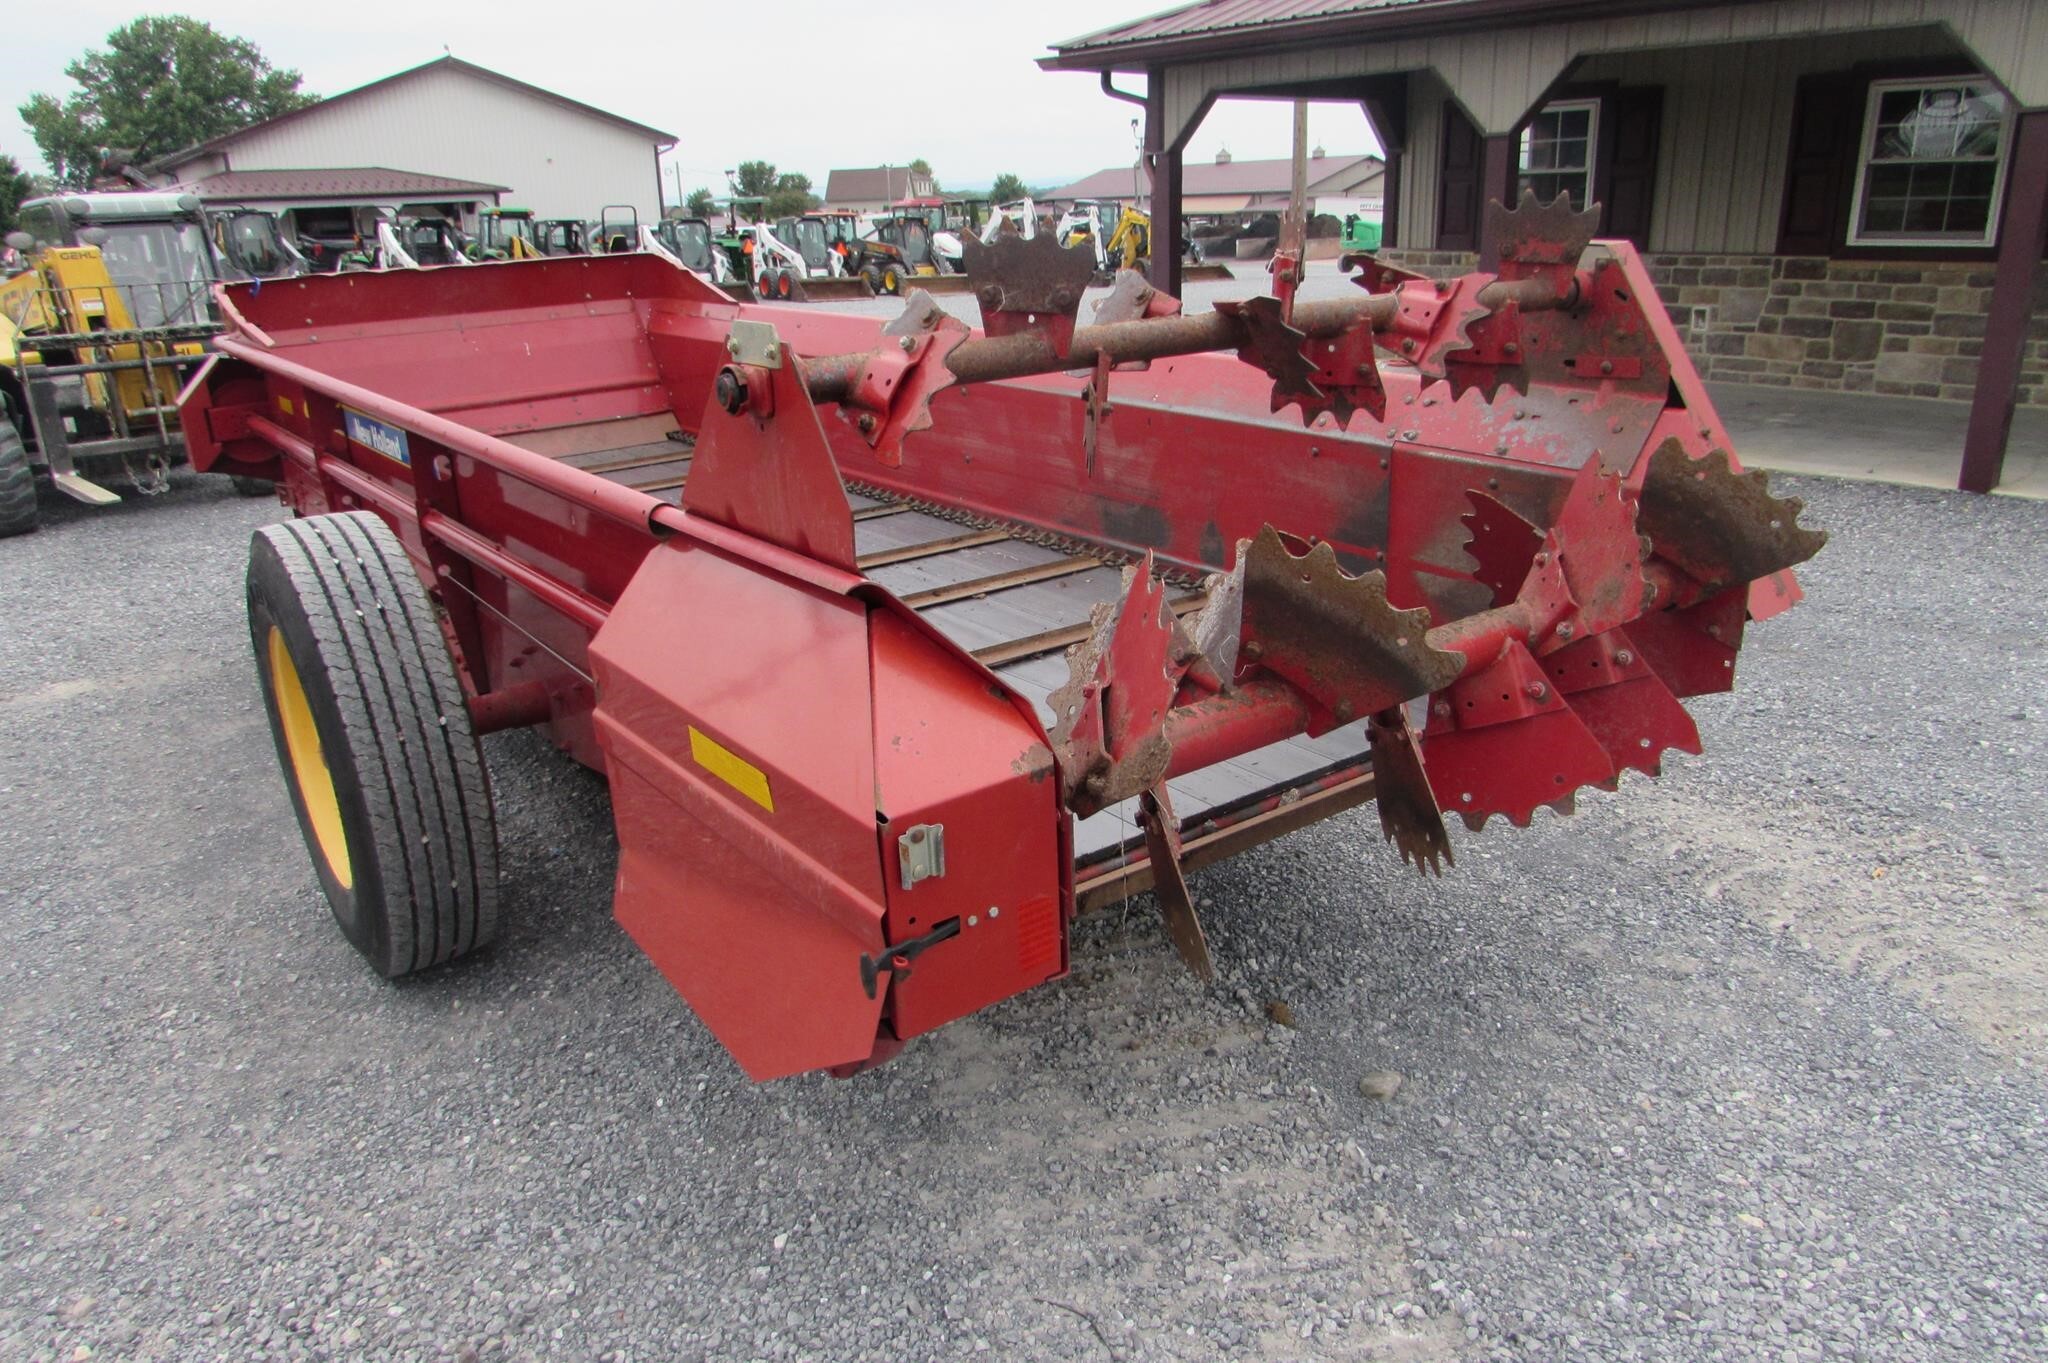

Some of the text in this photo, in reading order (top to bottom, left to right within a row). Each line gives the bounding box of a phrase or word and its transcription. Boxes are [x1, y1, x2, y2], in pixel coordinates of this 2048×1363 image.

[60, 252, 97, 260] GEHL
[354, 417, 402, 461] New Holland
